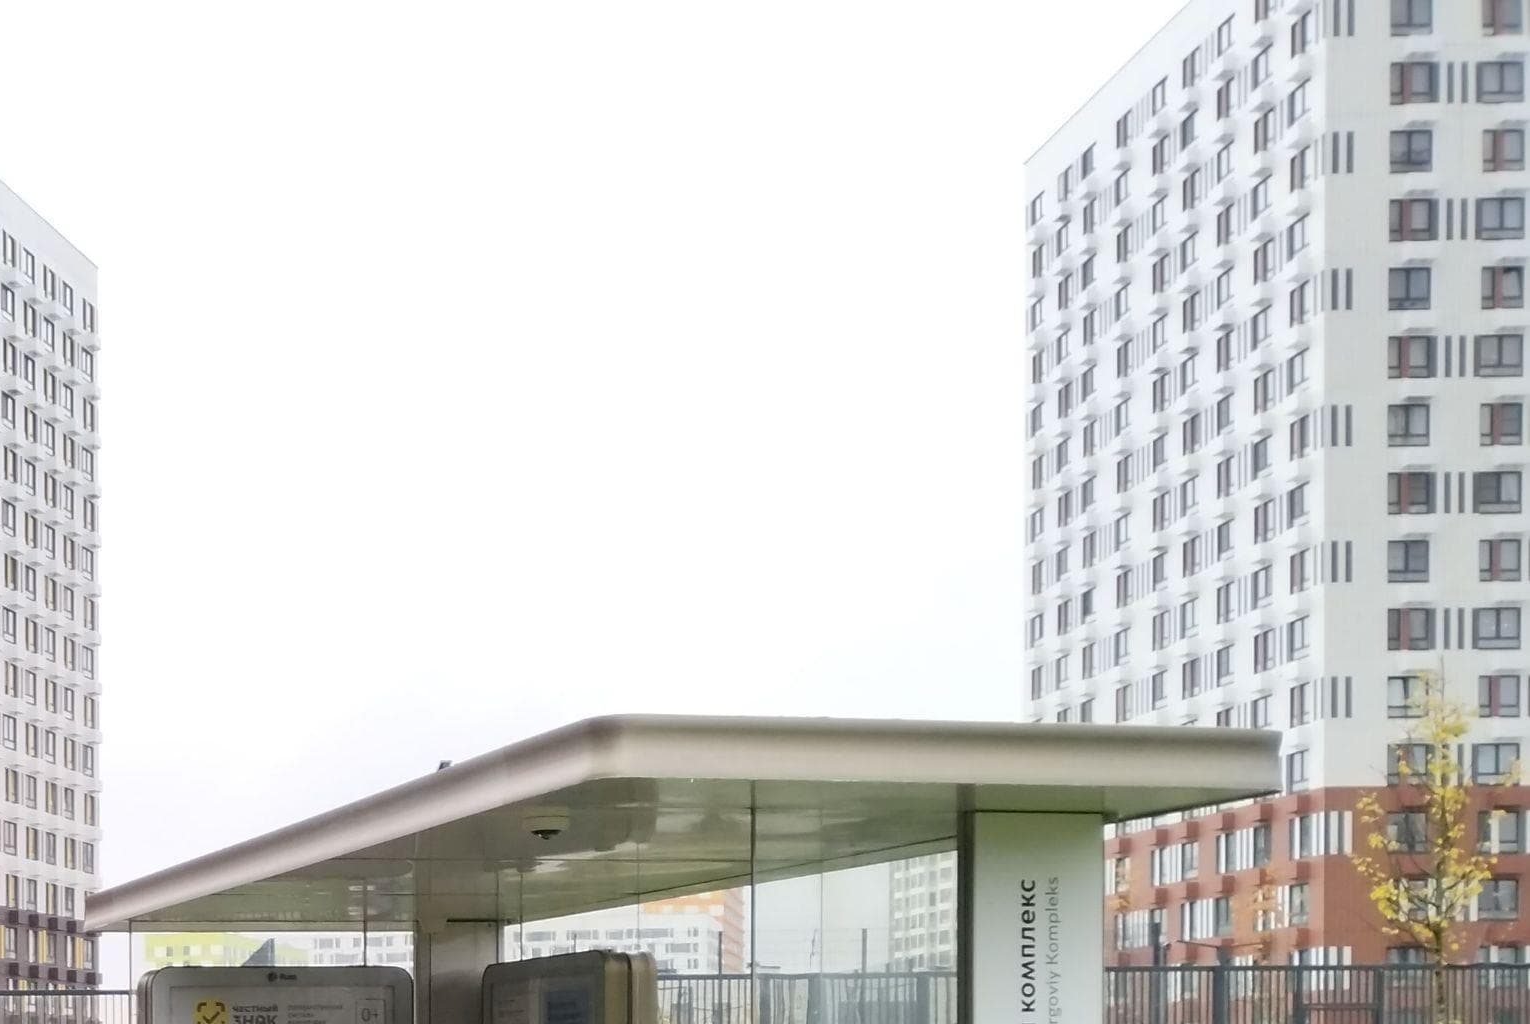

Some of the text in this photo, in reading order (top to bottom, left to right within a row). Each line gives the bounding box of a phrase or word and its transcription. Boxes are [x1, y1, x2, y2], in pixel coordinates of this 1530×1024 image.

[1021, 879, 1036, 1012] комплекс
[1045, 876, 1062, 964] Kompleks
[361, 1007, 379, 1022] 0+
